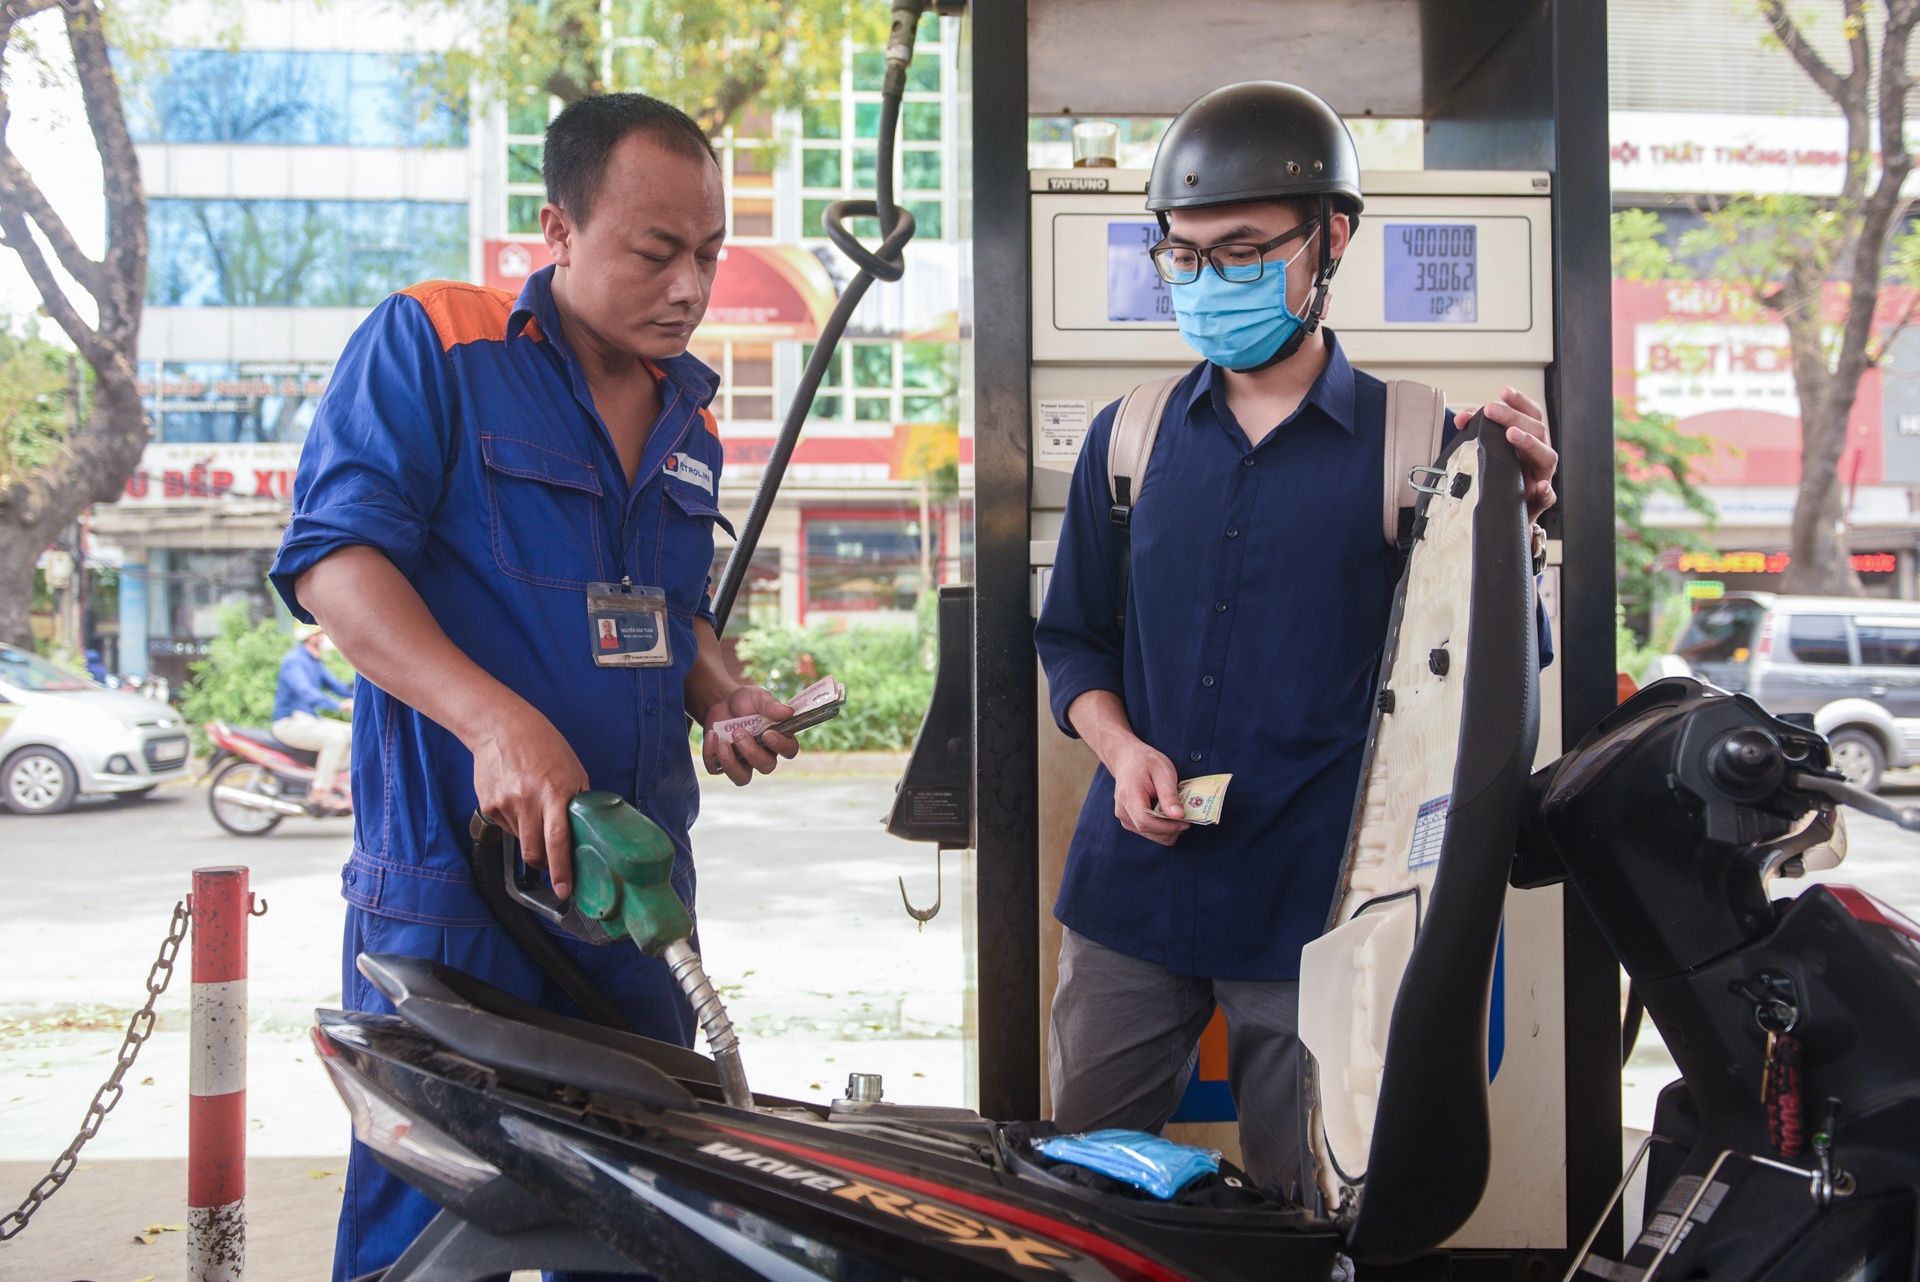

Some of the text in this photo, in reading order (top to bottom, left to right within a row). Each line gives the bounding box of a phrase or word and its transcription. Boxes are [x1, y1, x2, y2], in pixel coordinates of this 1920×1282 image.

[1050, 179, 1107, 190] TATSUNO
[1402, 228, 1474, 256] 400000
[1428, 296, 1474, 316] 10240
[164, 457, 234, 498] BẾP
[254, 470, 296, 498] XU
[696, 1141, 1077, 1271] wave RSX
